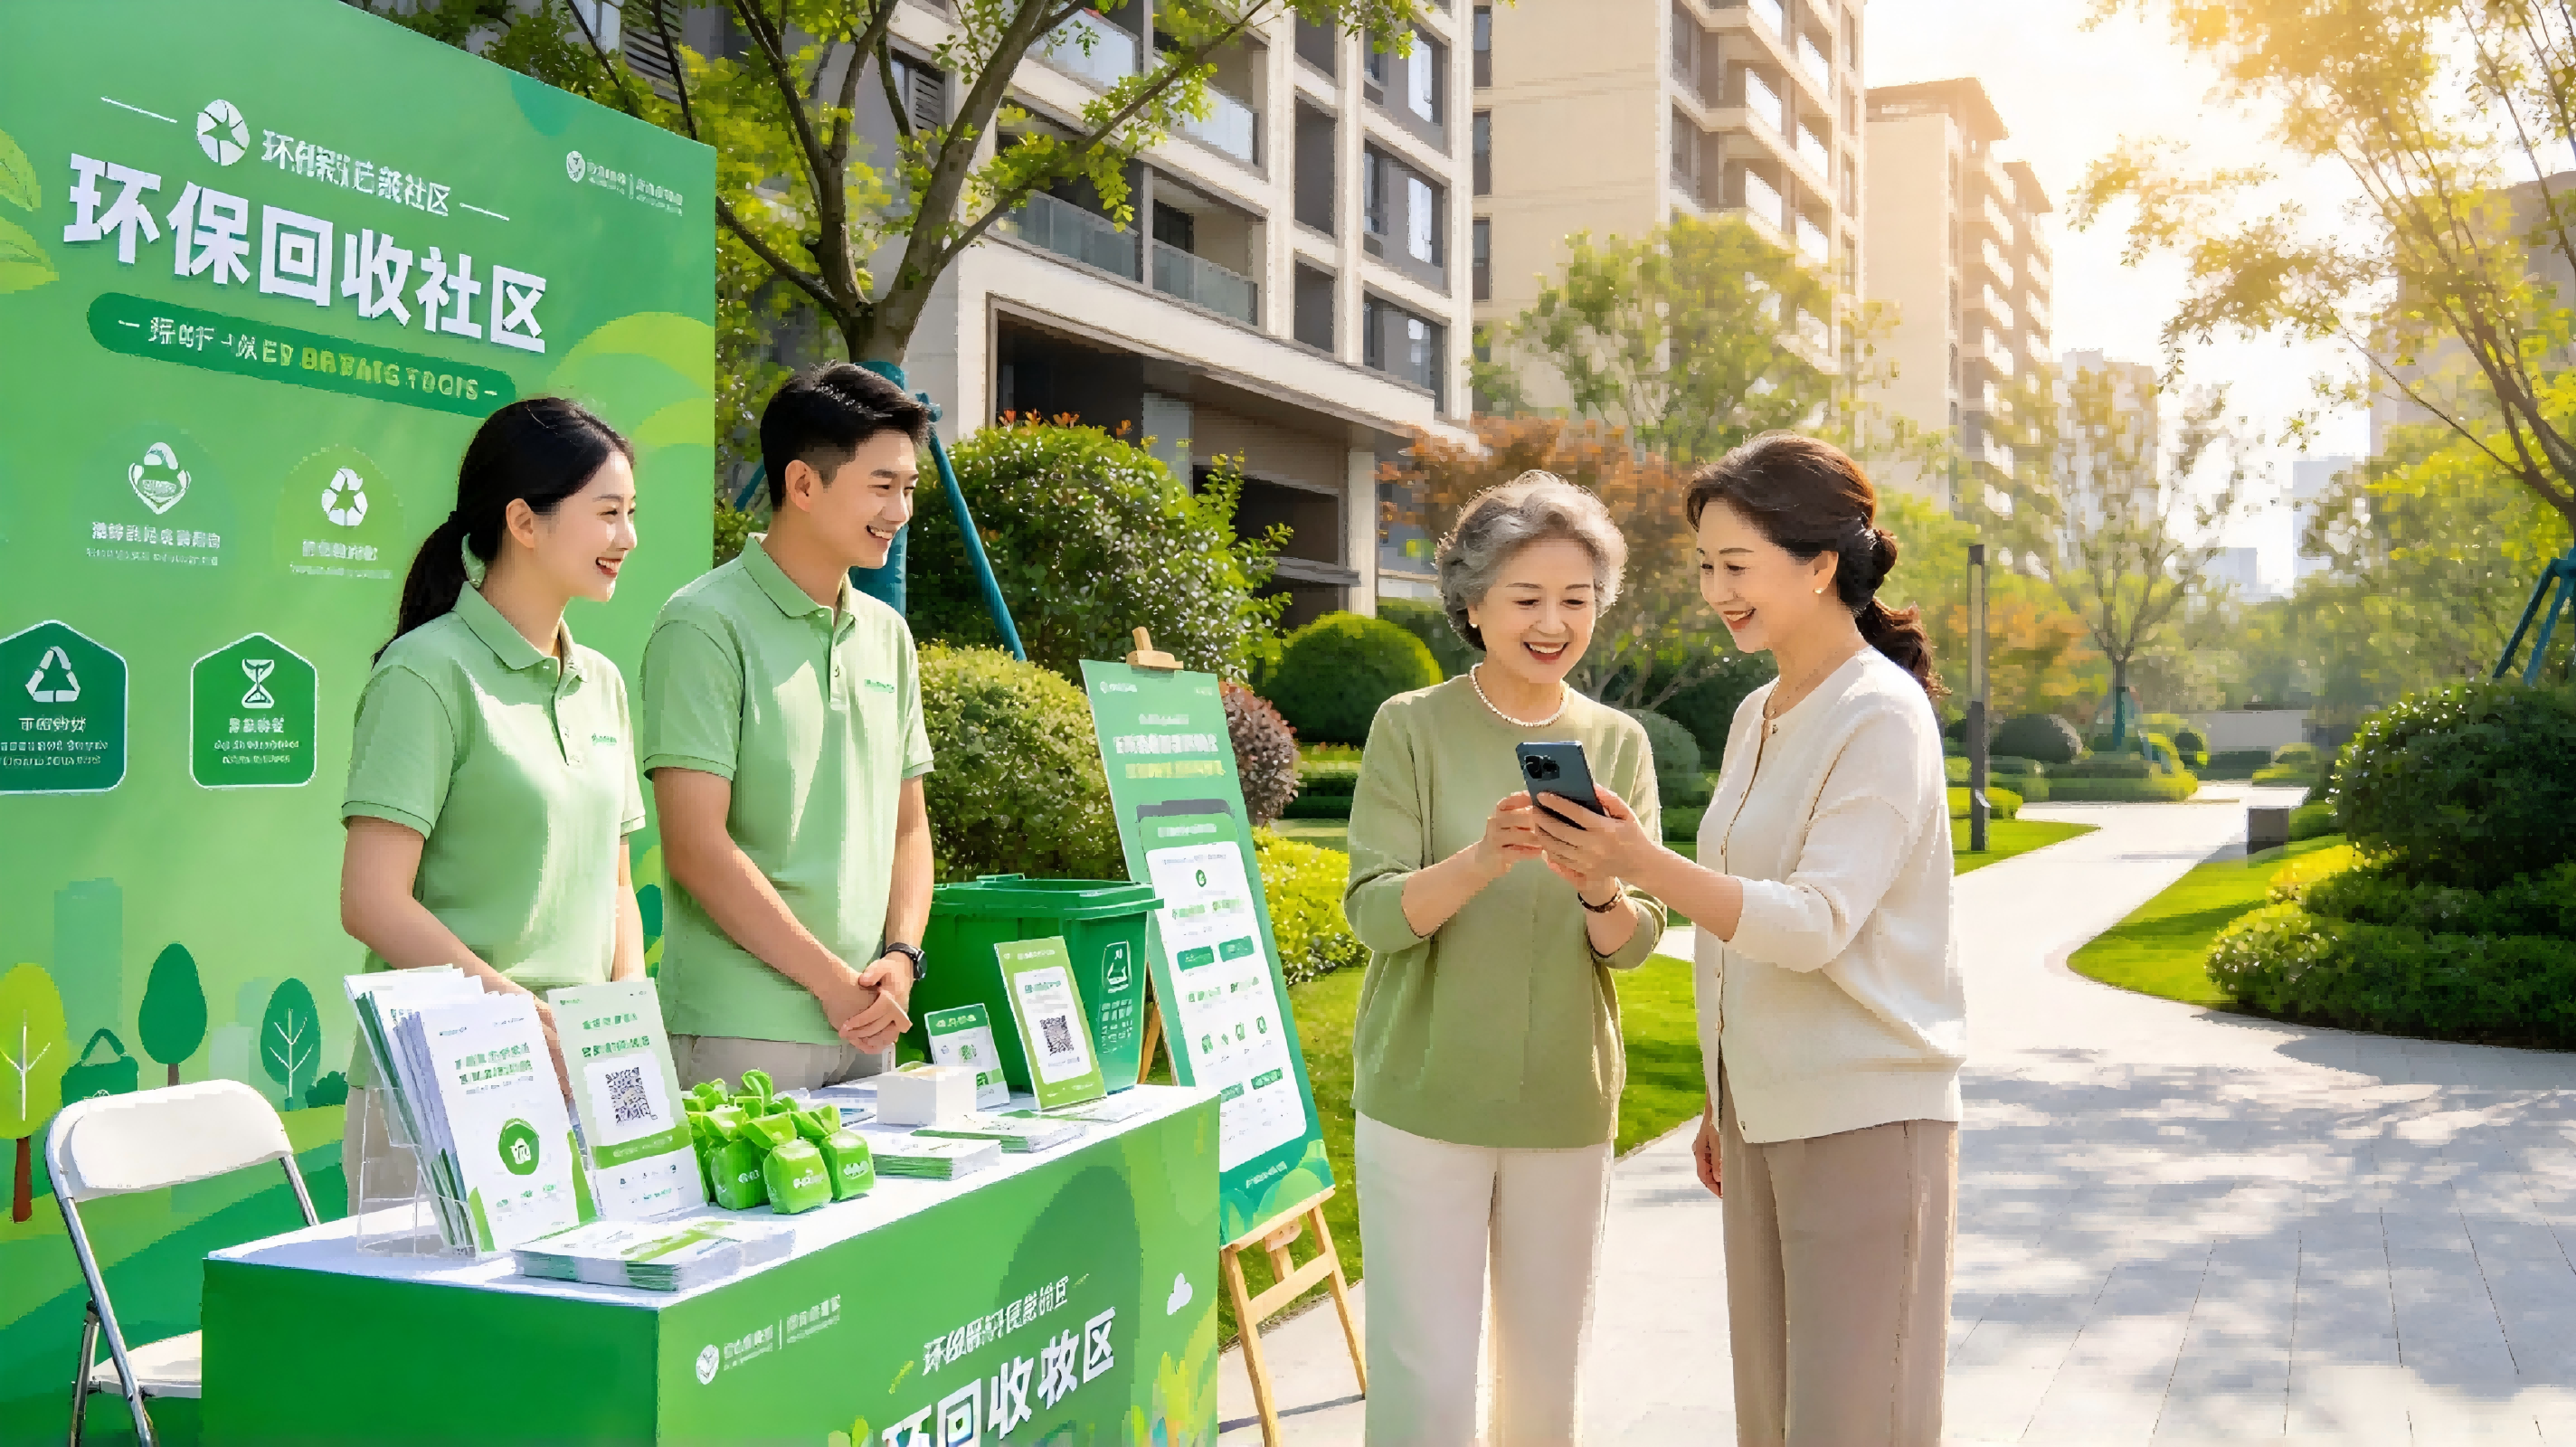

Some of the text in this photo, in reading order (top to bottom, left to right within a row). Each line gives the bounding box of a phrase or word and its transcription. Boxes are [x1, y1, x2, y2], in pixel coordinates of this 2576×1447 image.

[63, 153, 546, 353] 环保回收社区
